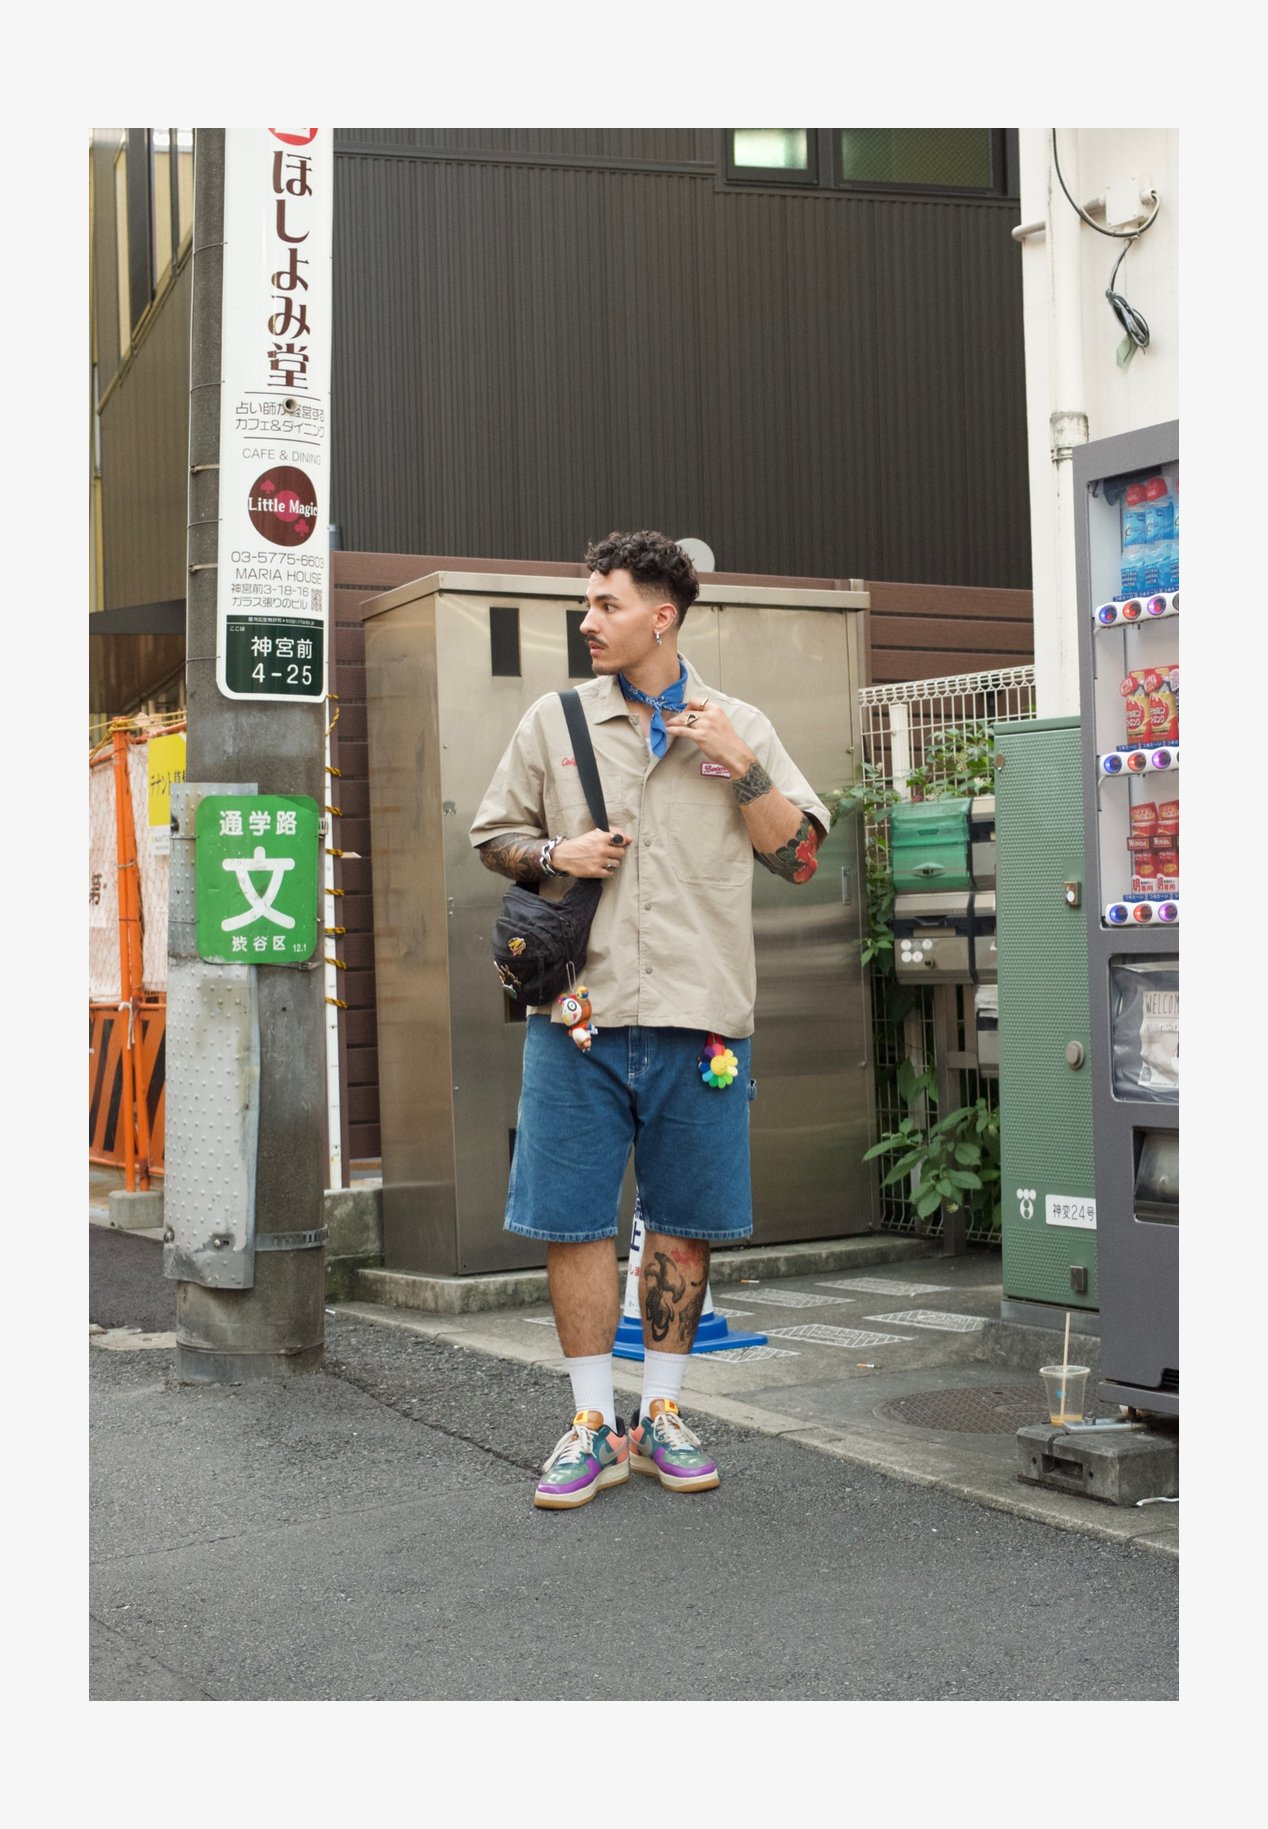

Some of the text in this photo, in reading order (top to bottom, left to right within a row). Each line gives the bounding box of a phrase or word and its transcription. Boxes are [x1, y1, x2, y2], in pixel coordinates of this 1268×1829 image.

[267, 150, 313, 390] ほしよみ堂
[242, 447, 276, 460] CAFE
[279, 449, 288, 461] &
[248, 496, 319, 518] Little Magic
[230, 551, 324, 569] 03-5775-6603
[236, 567, 322, 585] MARIA HOUSE
[251, 636, 312, 659] 神宮前
[252, 663, 312, 685] 4-25
[219, 810, 297, 836] 通学路
[221, 846, 296, 932] 文
[232, 936, 287, 952] 渋谷区
[1053, 1203, 1095, 1222] 神変24号
